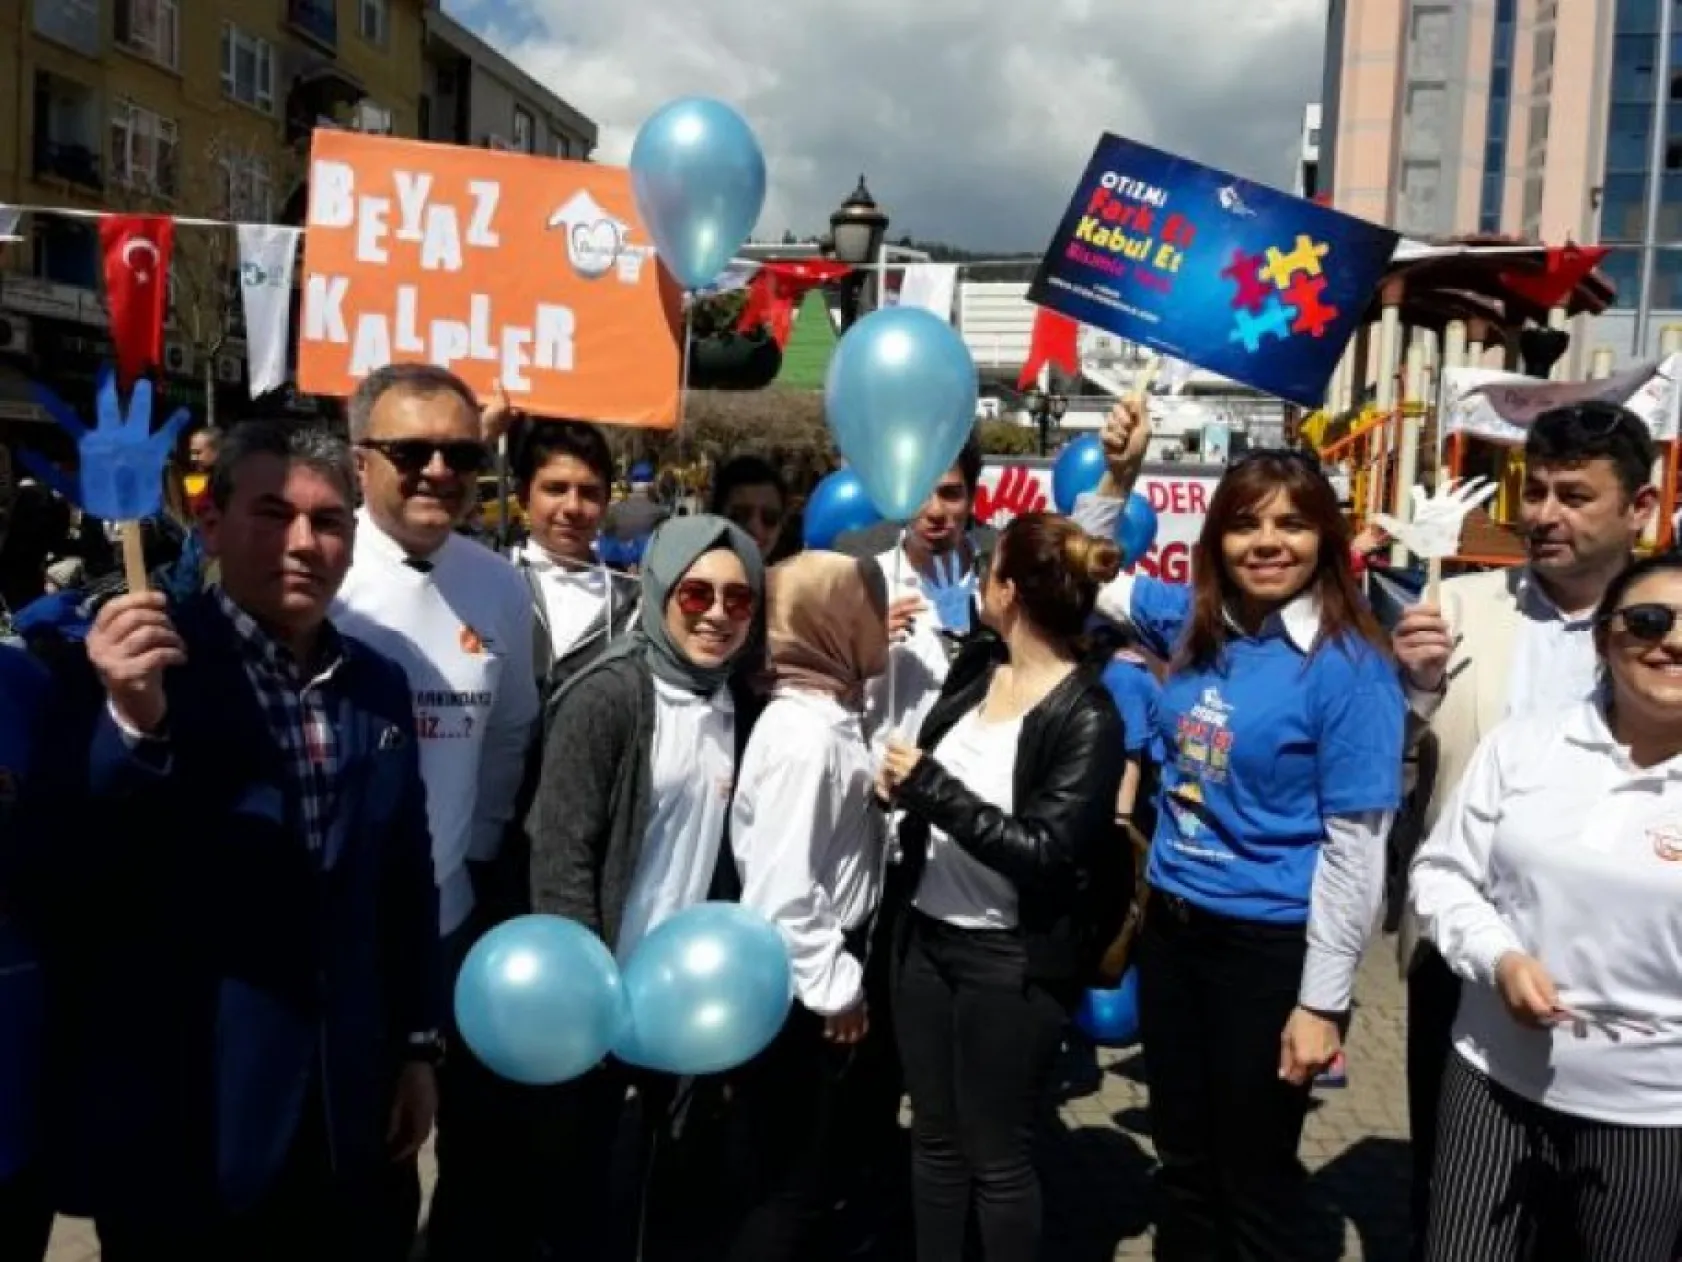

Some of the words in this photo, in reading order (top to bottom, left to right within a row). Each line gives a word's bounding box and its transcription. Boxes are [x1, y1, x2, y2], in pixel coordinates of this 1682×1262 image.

[312, 161, 499, 271] BEYAZ
[1075, 215, 1152, 261] Kabul
[1152, 243, 1183, 273] Et
[1088, 187, 1155, 233] Fark
[1161, 212, 1196, 248] Et
[304, 273, 575, 392] KALPLER
